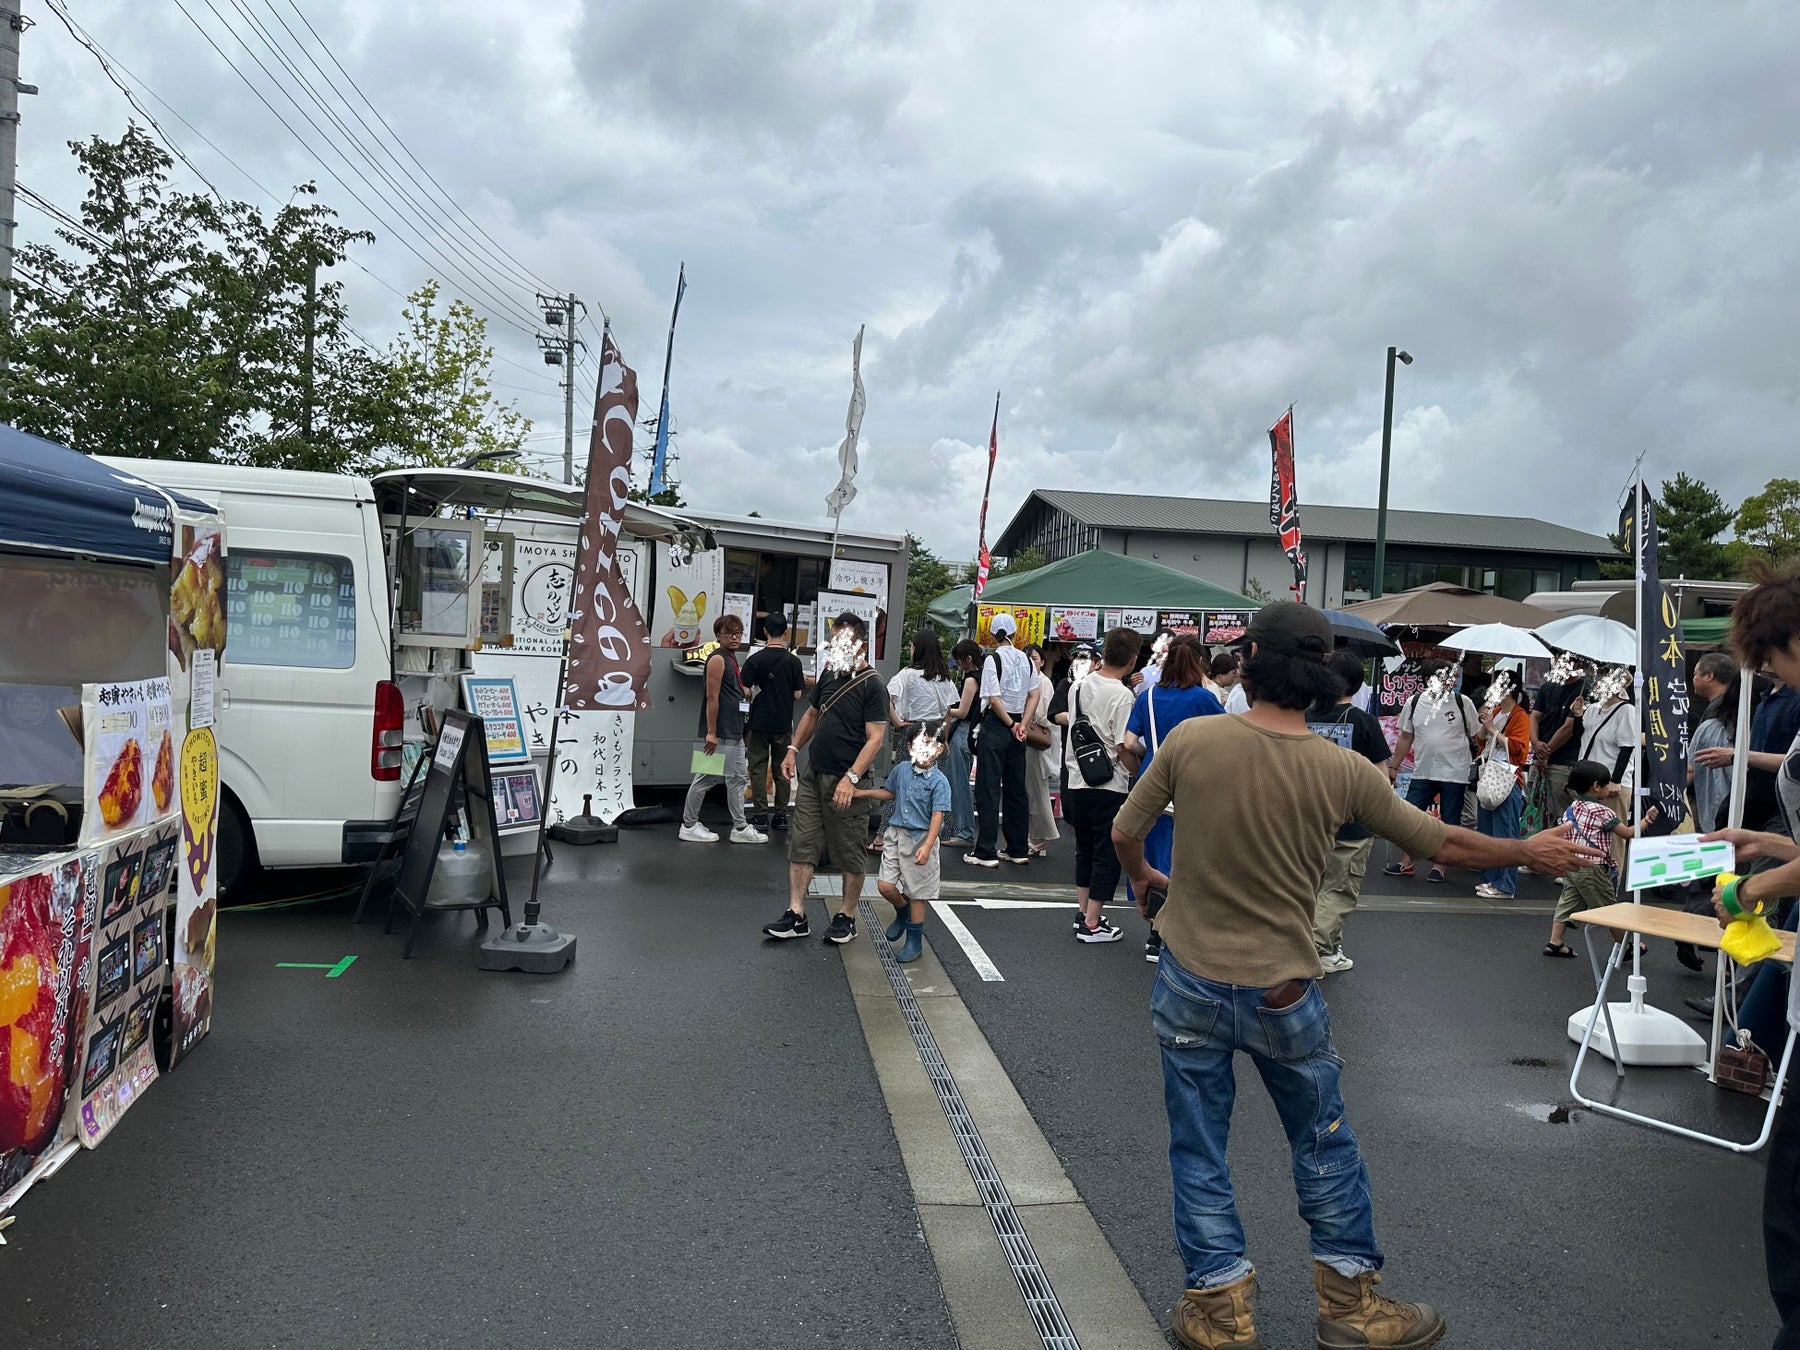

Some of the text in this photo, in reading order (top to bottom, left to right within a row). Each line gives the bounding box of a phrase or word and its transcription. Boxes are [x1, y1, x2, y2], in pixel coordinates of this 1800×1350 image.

[519, 546, 556, 556] IMOYA
[558, 710, 580, 775] 本一の
